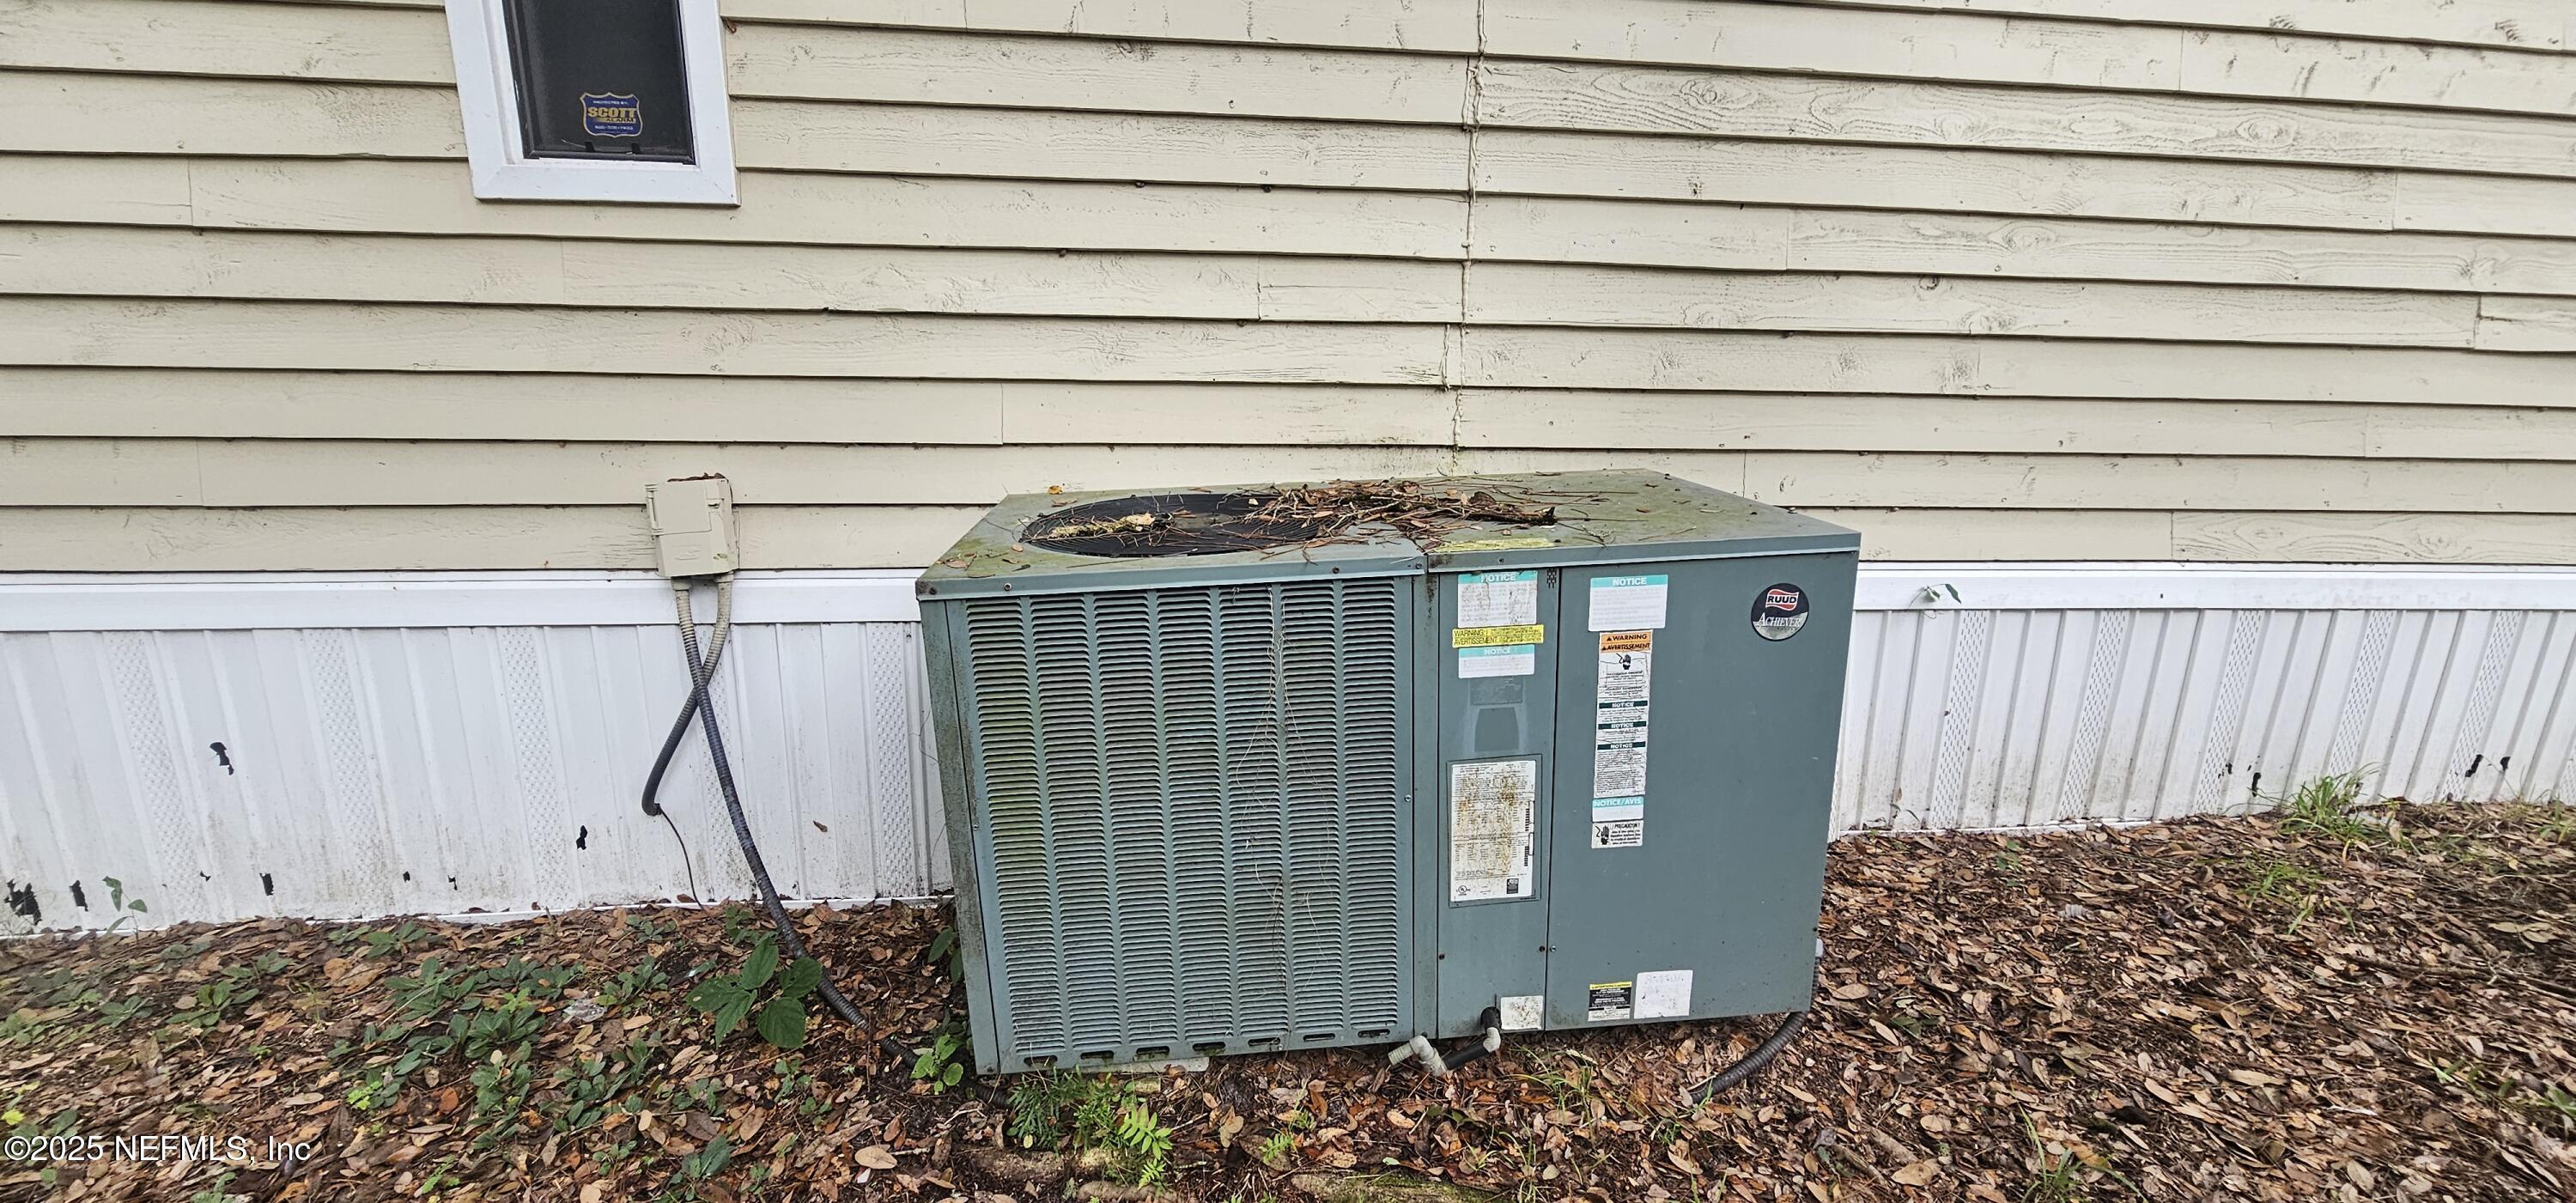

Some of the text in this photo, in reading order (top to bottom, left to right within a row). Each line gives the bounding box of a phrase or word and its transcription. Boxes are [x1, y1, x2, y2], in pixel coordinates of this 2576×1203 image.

[587, 106, 637, 118] SCOTT
[1480, 574, 1517, 583] NOTICE
[1612, 577, 1648, 586] NOTICE
[1607, 642, 1650, 651] AVERTISSEMENT
[1593, 798, 1642, 807] NOTICE/AVIS
